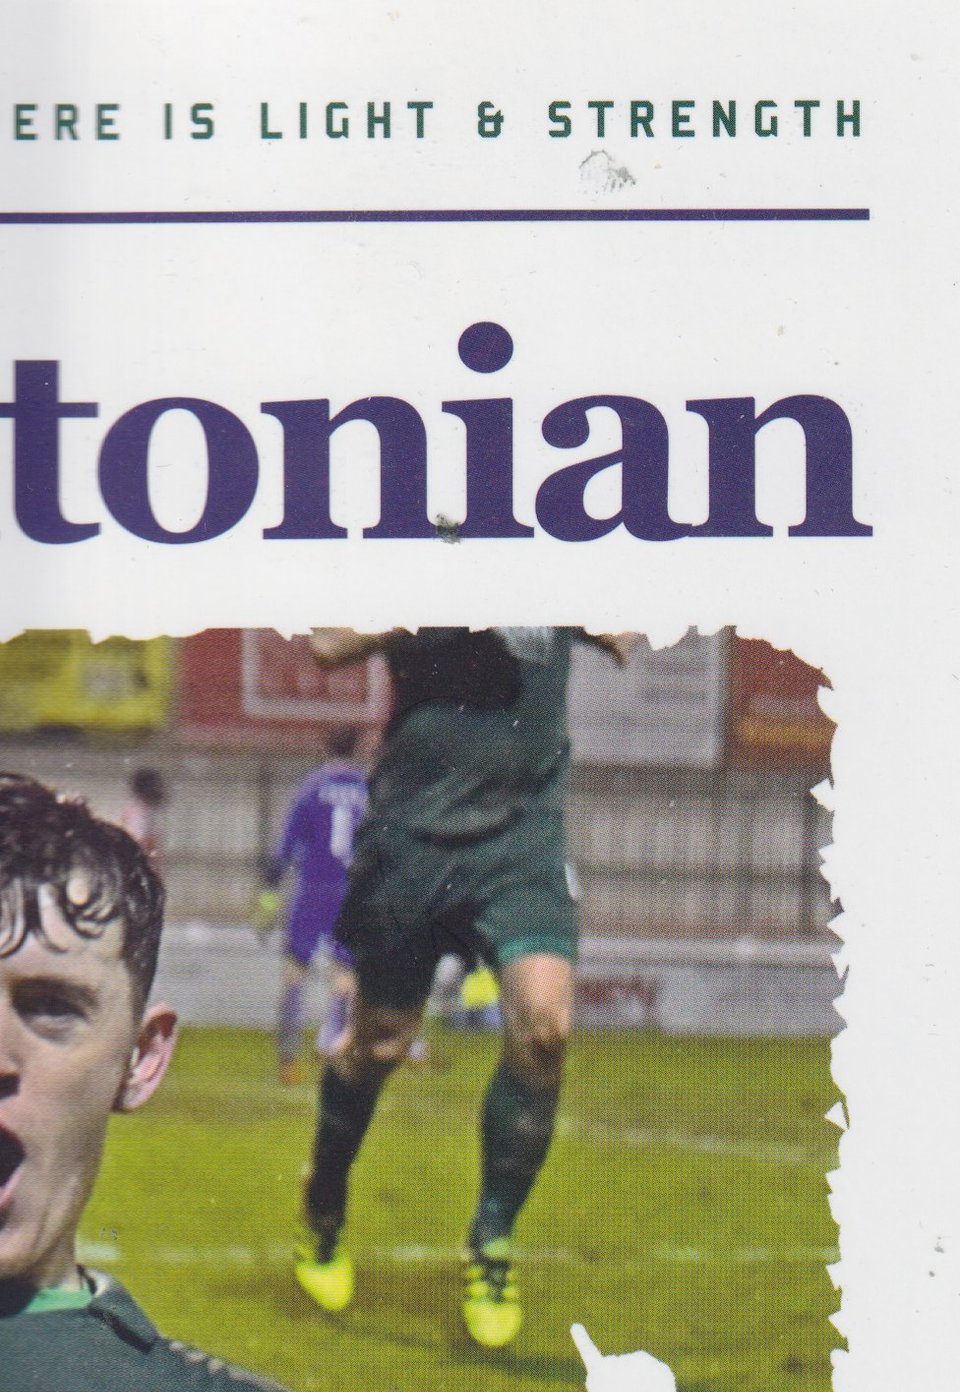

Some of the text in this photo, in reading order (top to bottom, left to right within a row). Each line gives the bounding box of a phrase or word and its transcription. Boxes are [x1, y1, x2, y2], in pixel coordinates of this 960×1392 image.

[165, 103, 214, 140] IS
[261, 102, 433, 139] LIGHT
[478, 101, 504, 138] &
[549, 100, 860, 138] STRENGTH
